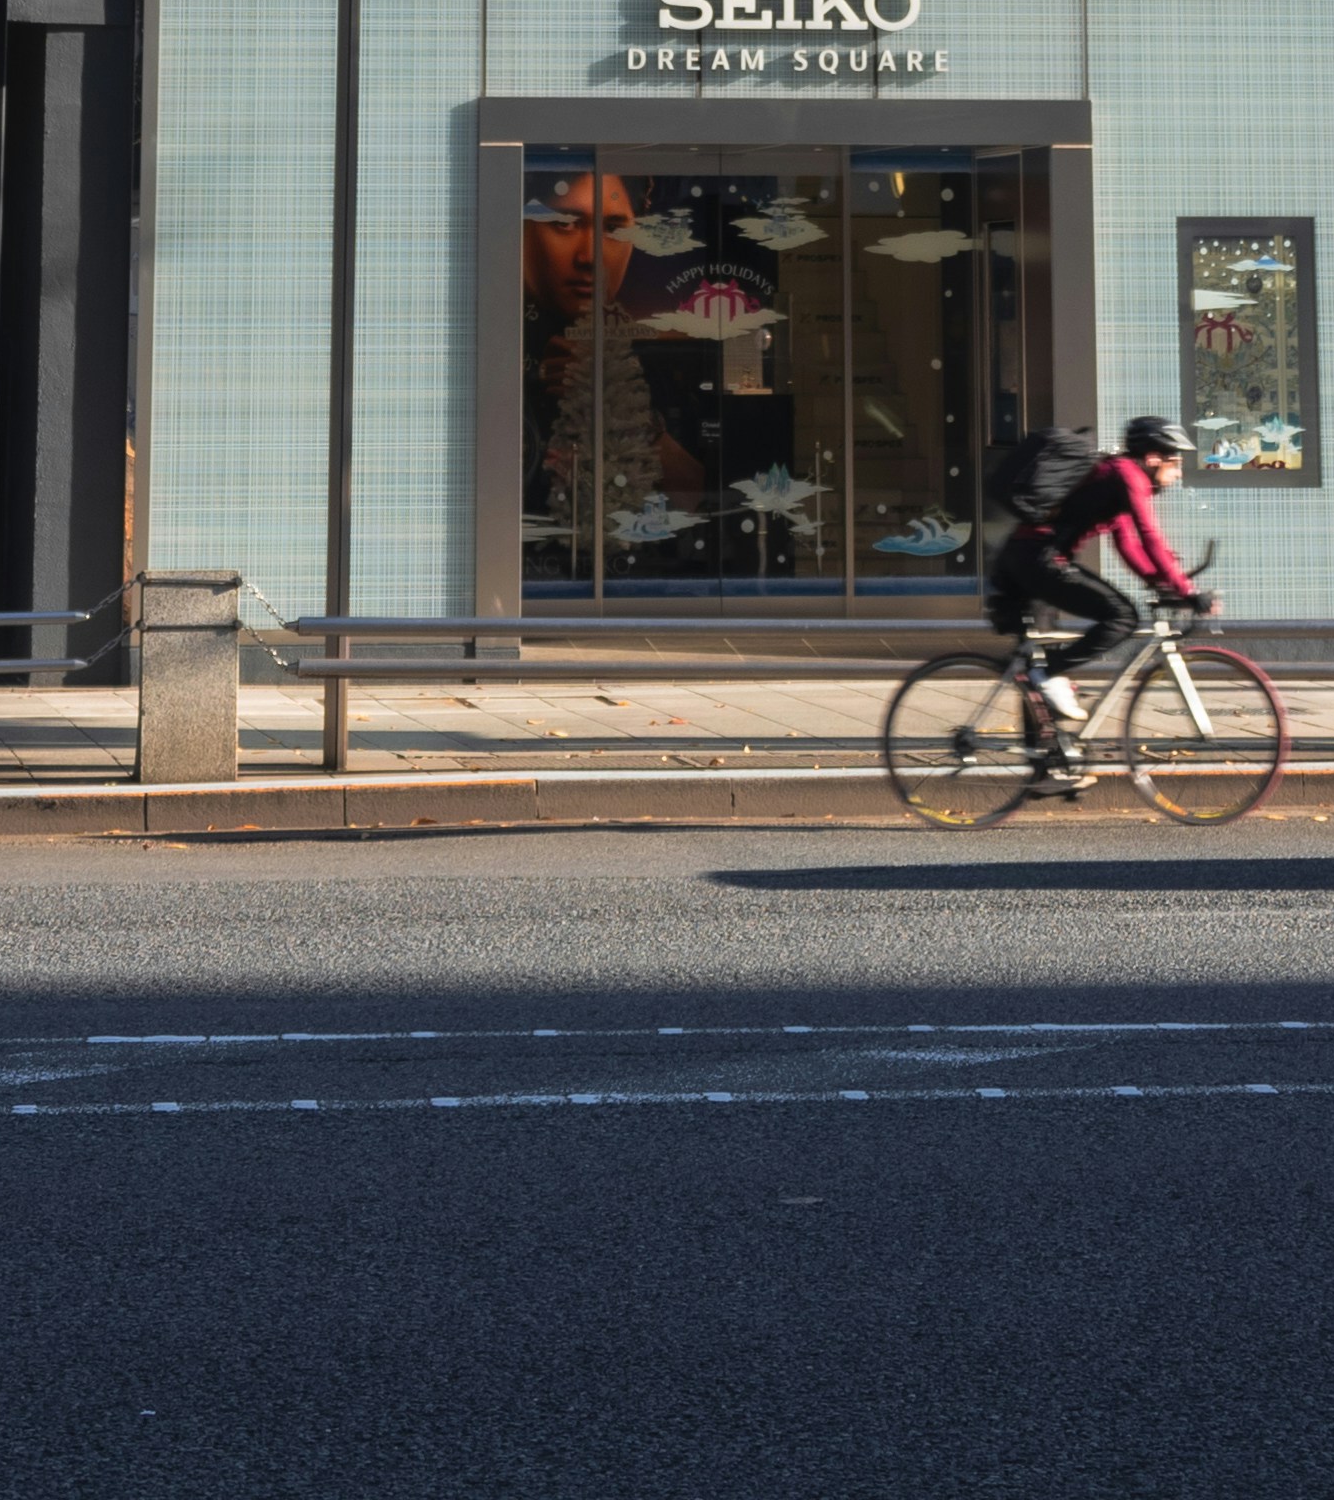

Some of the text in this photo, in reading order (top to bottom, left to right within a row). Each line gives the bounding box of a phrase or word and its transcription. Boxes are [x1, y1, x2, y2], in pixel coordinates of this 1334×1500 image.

[627, 47, 950, 74] DREAM SQUARE
[665, 262, 775, 296] HAPPY HOLIDAYS
